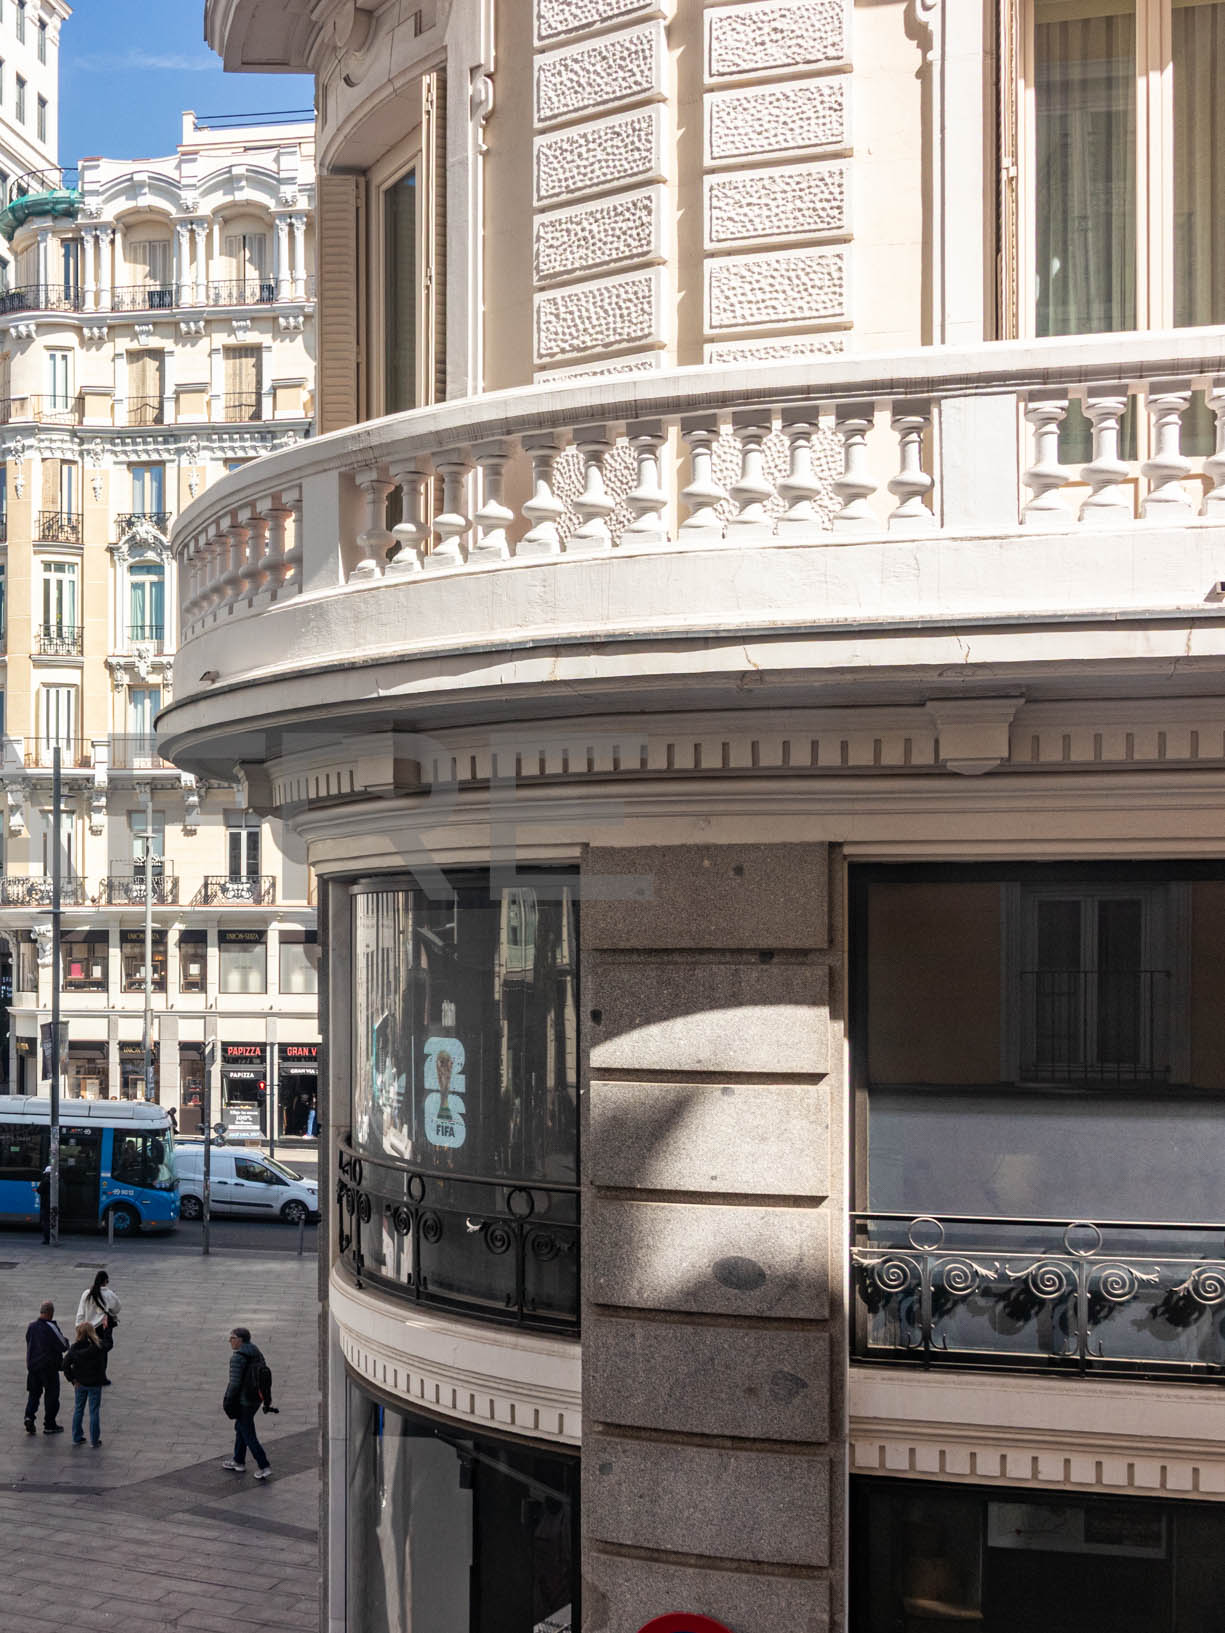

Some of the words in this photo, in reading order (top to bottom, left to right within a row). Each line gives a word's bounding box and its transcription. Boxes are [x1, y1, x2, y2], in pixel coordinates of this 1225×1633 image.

[227, 1046, 261, 1056] PAPIZZA
[287, 1046, 309, 1056] GRAN
[436, 1124, 455, 1138] FIFA
